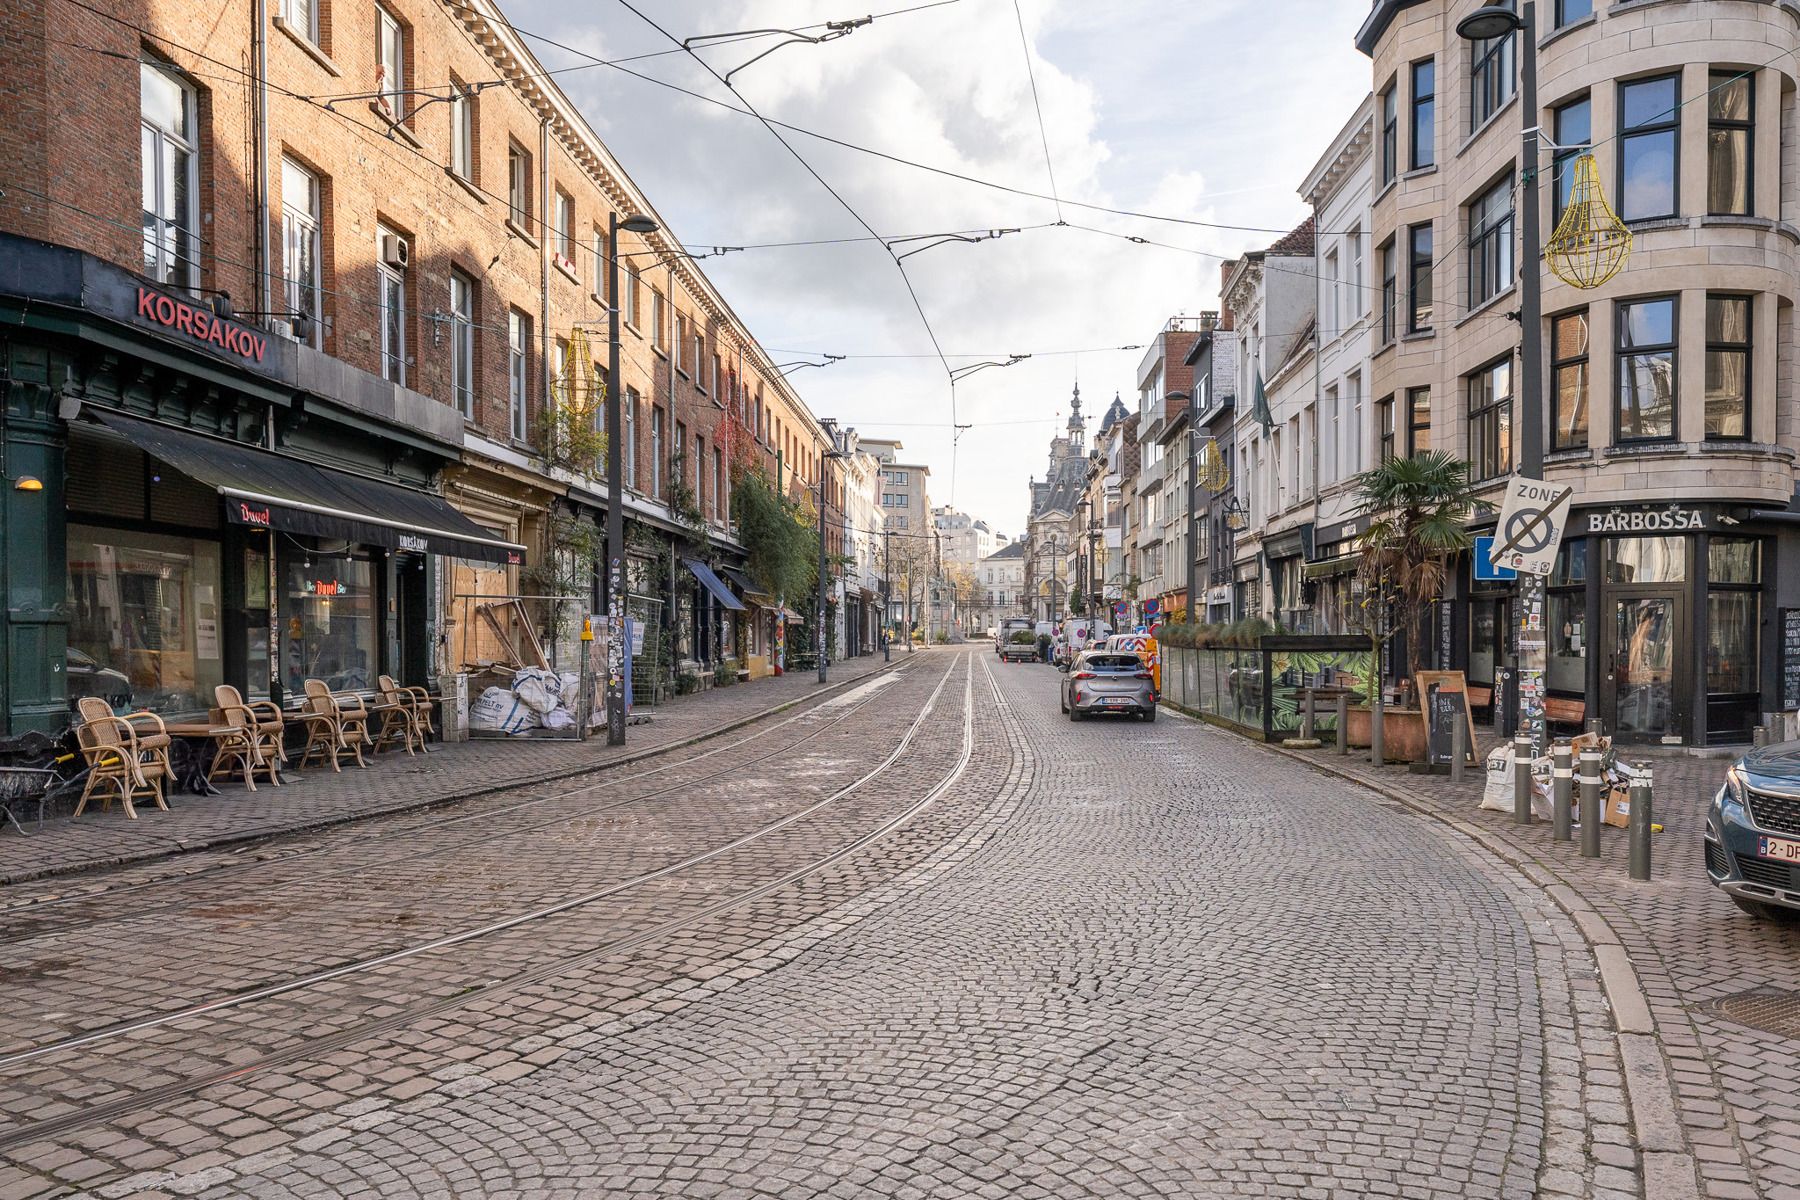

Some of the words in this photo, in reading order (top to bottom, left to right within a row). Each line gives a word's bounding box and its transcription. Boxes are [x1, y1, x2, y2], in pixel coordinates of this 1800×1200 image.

[137, 287, 267, 363] KORSAKOV
[1517, 484, 1561, 502] ZONE
[240, 503, 270, 526] Duvel
[1588, 509, 1704, 532] BARBOSSA
[399, 535, 428, 550] KORSAKOV
[316, 580, 337, 595] Duvel
